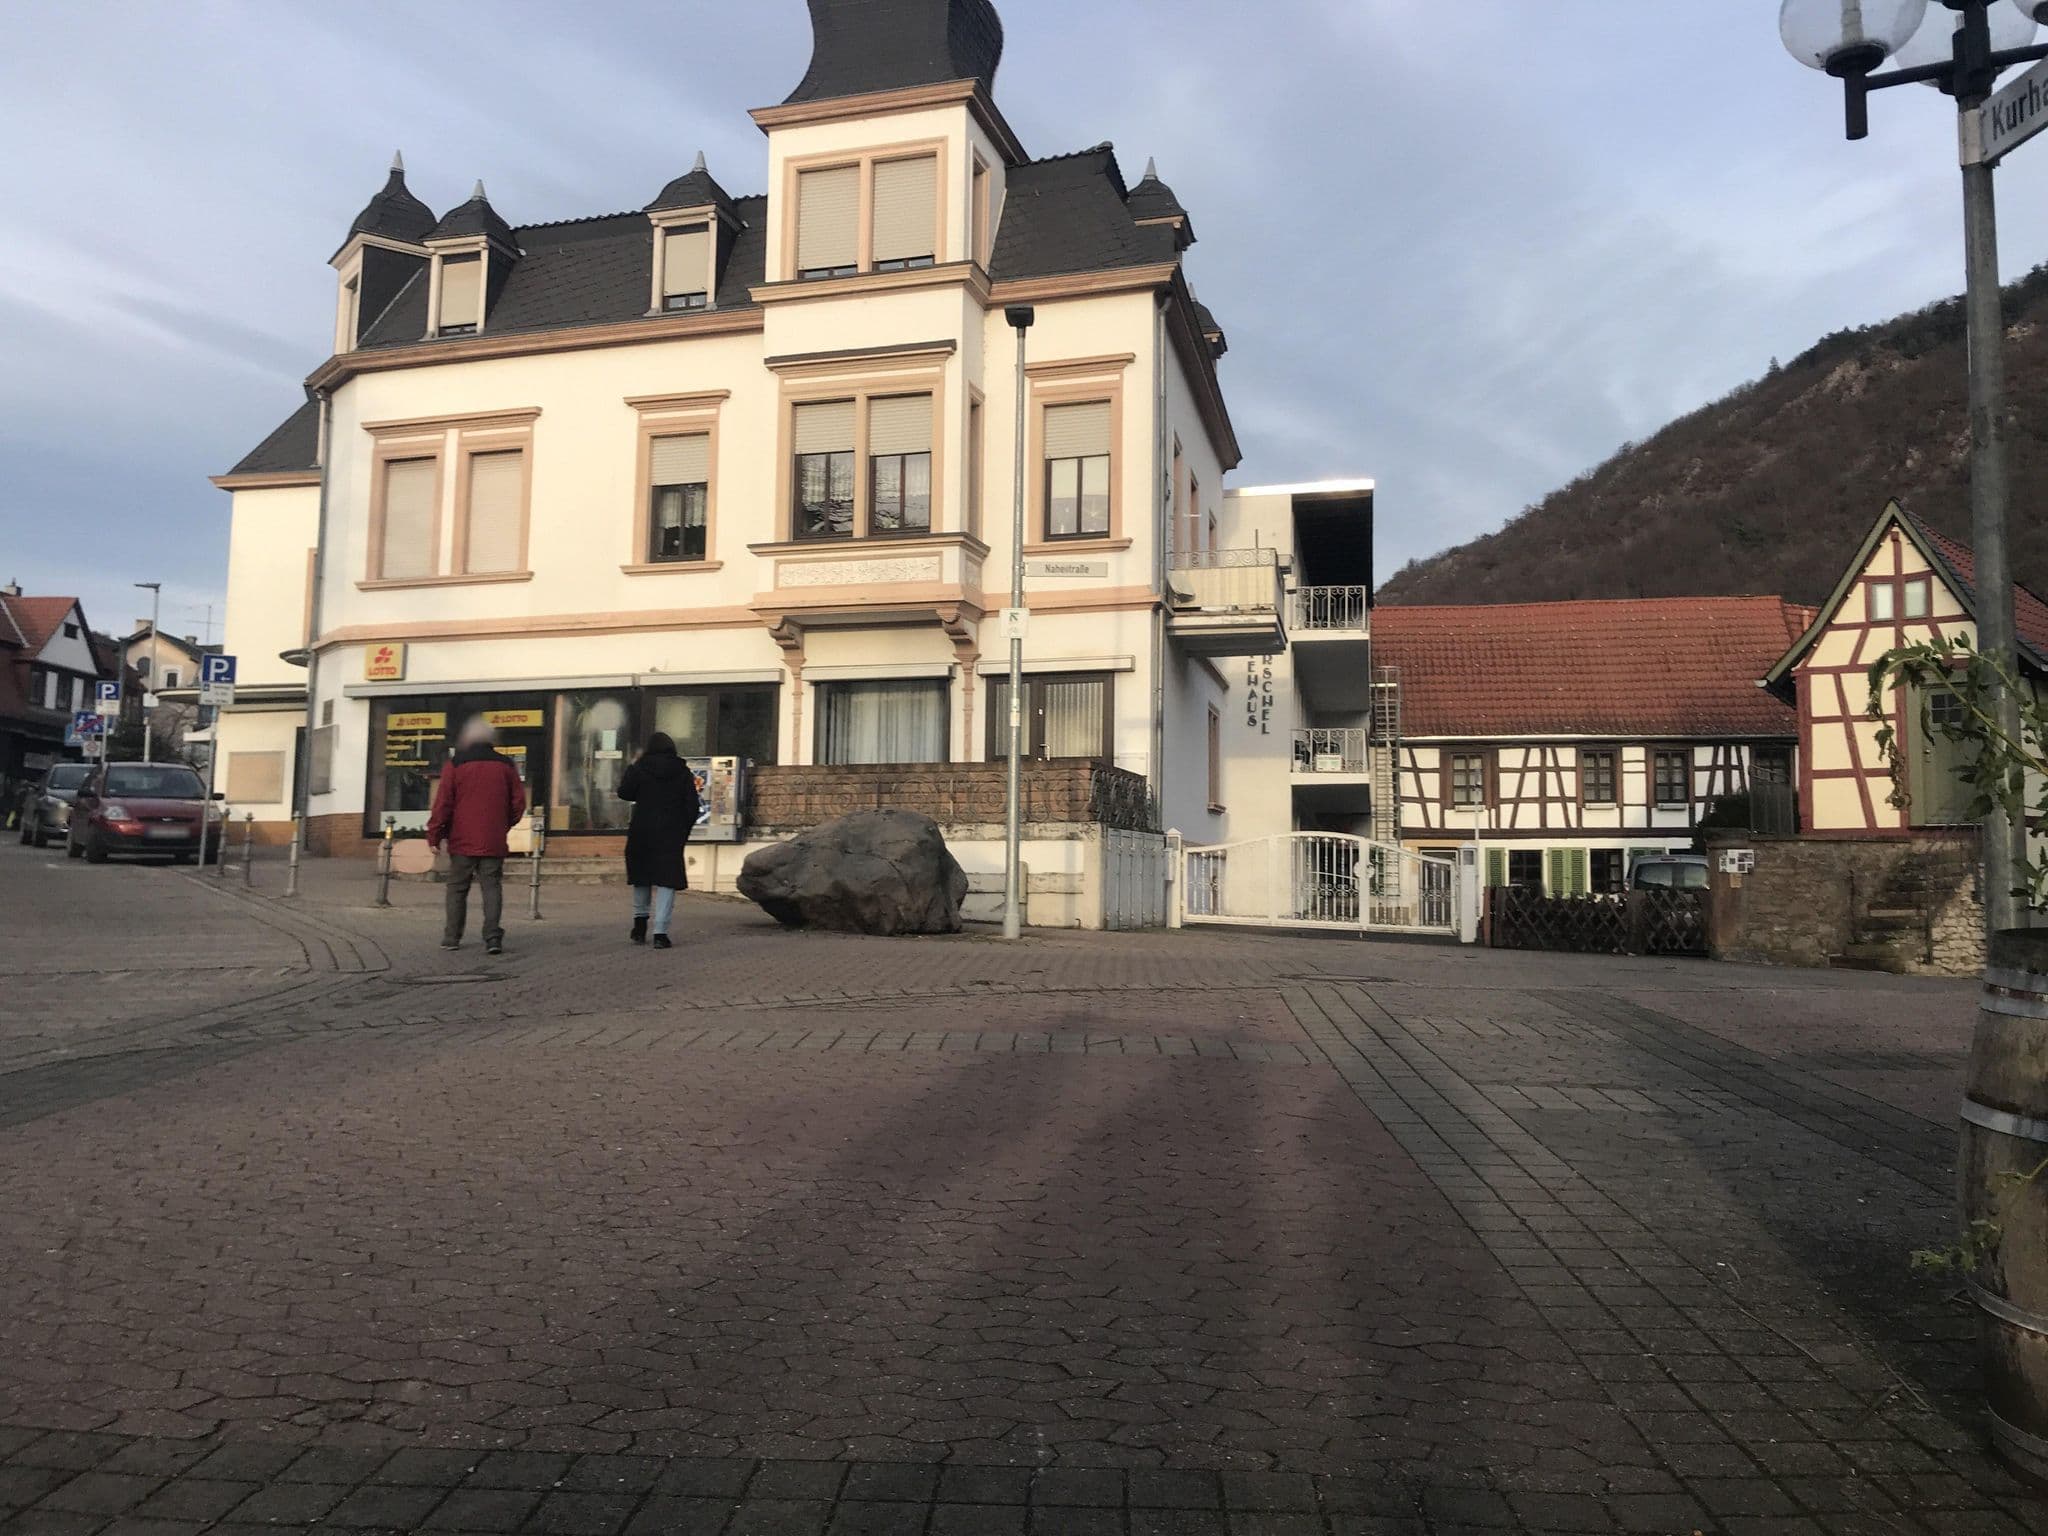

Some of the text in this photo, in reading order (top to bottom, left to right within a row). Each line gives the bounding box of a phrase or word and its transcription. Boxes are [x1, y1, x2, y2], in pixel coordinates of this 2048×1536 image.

[1045, 563, 1090, 574] Nahestraße
[209, 658, 229, 681] P
[368, 666, 397, 676] LOTTO
[101, 684, 116, 699] P
[407, 717, 432, 726] LOTTO
[502, 714, 528, 723] LOTTO
